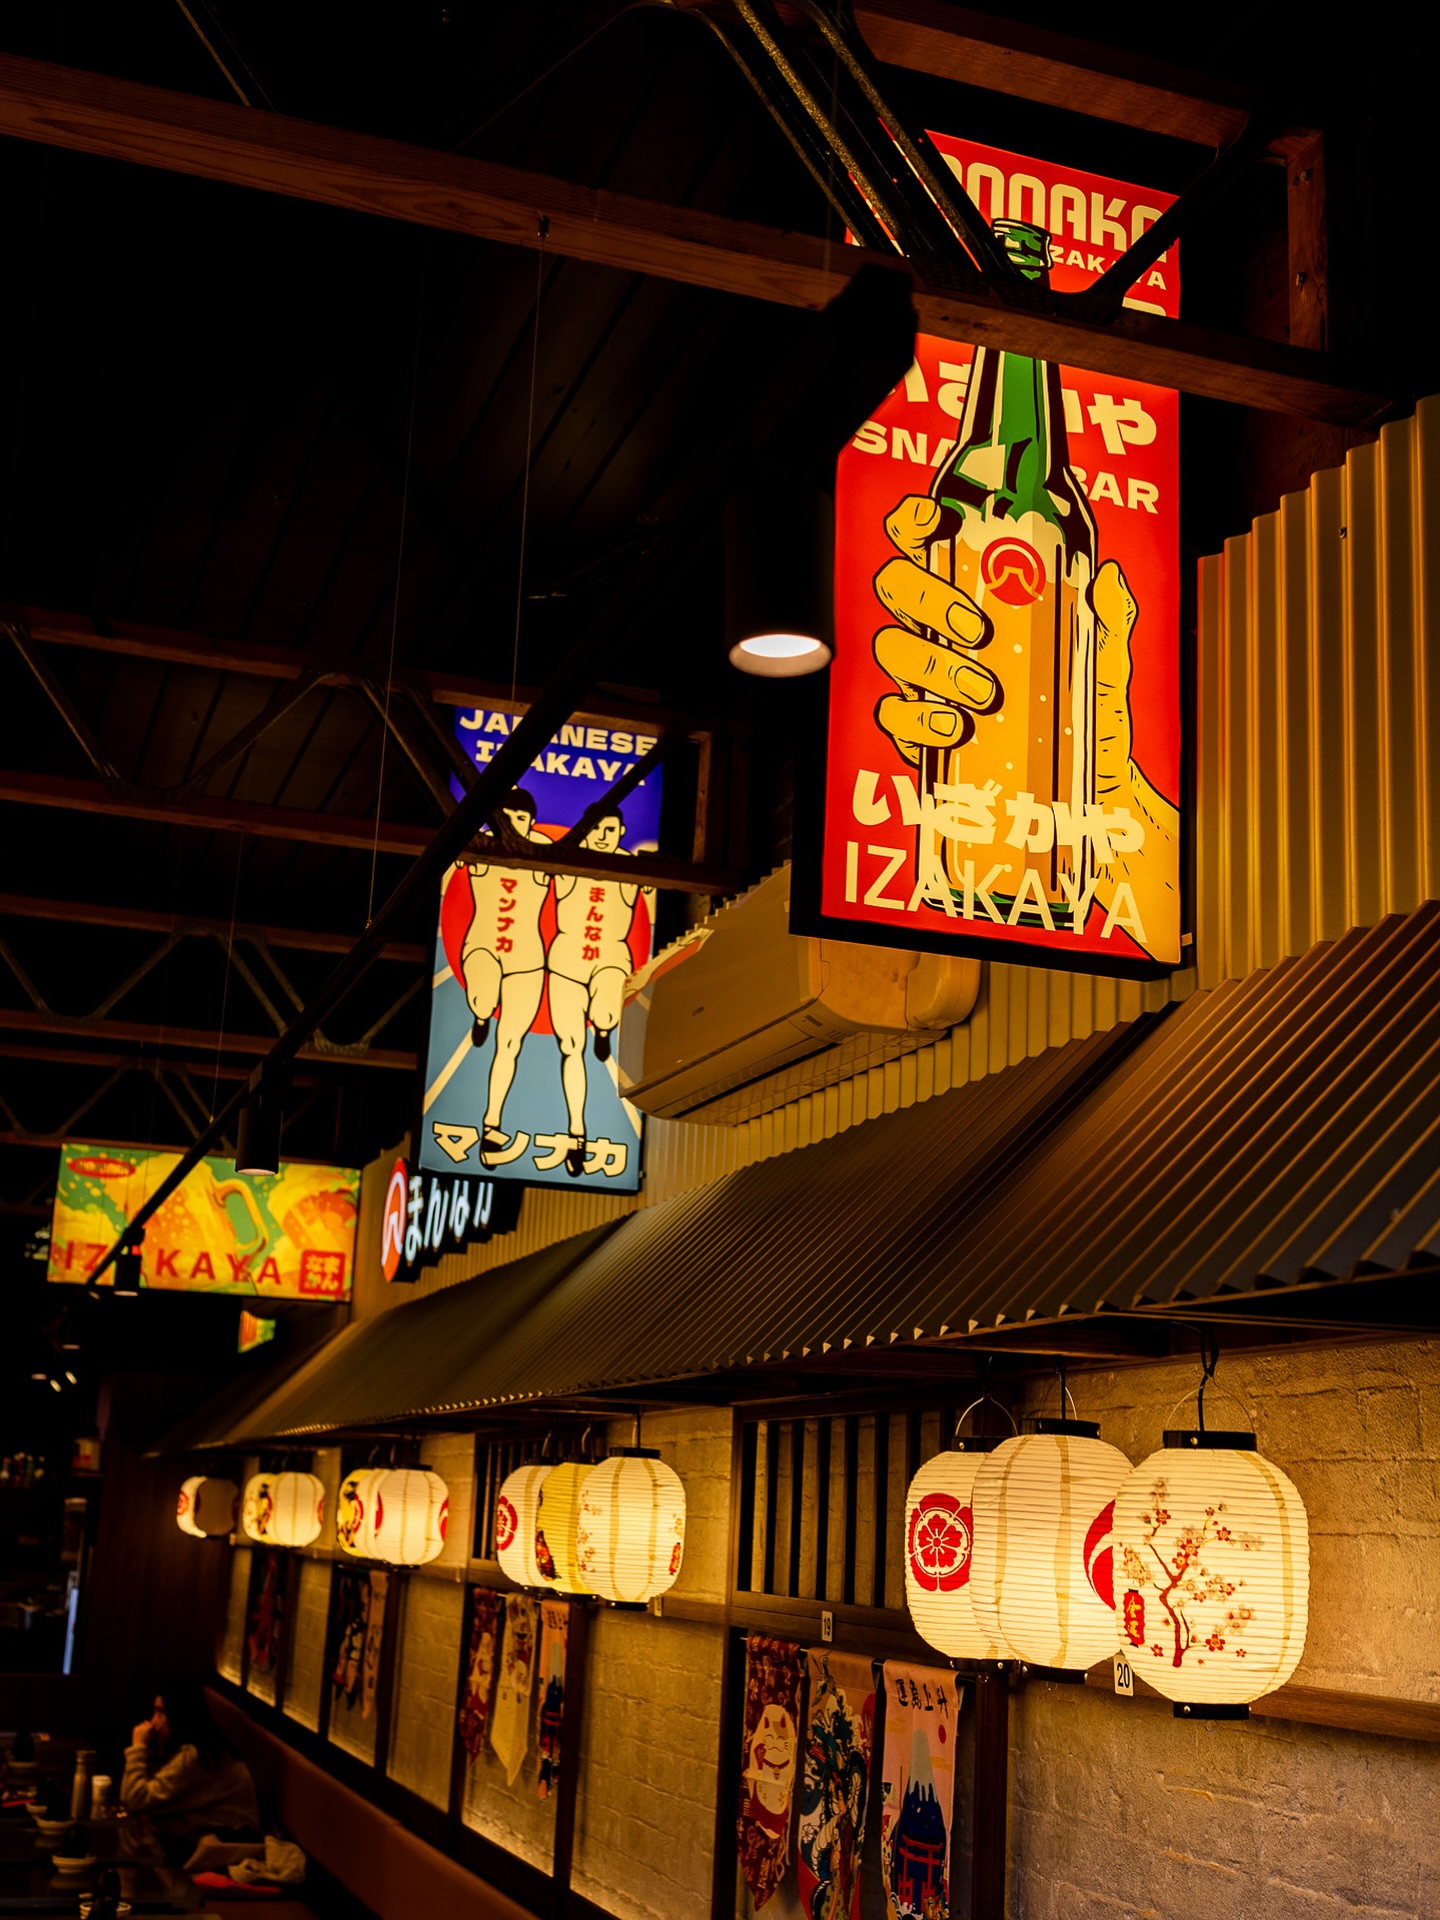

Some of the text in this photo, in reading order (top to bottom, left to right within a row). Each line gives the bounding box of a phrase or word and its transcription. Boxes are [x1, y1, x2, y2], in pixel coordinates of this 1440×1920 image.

[852, 769, 1146, 865] いざかや
[581, 886, 606, 961] まんなか
[845, 841, 1148, 944] IZAKAYA
[65, 1241, 282, 1286] IZKAYA
[1116, 1662, 1131, 1689] 20
